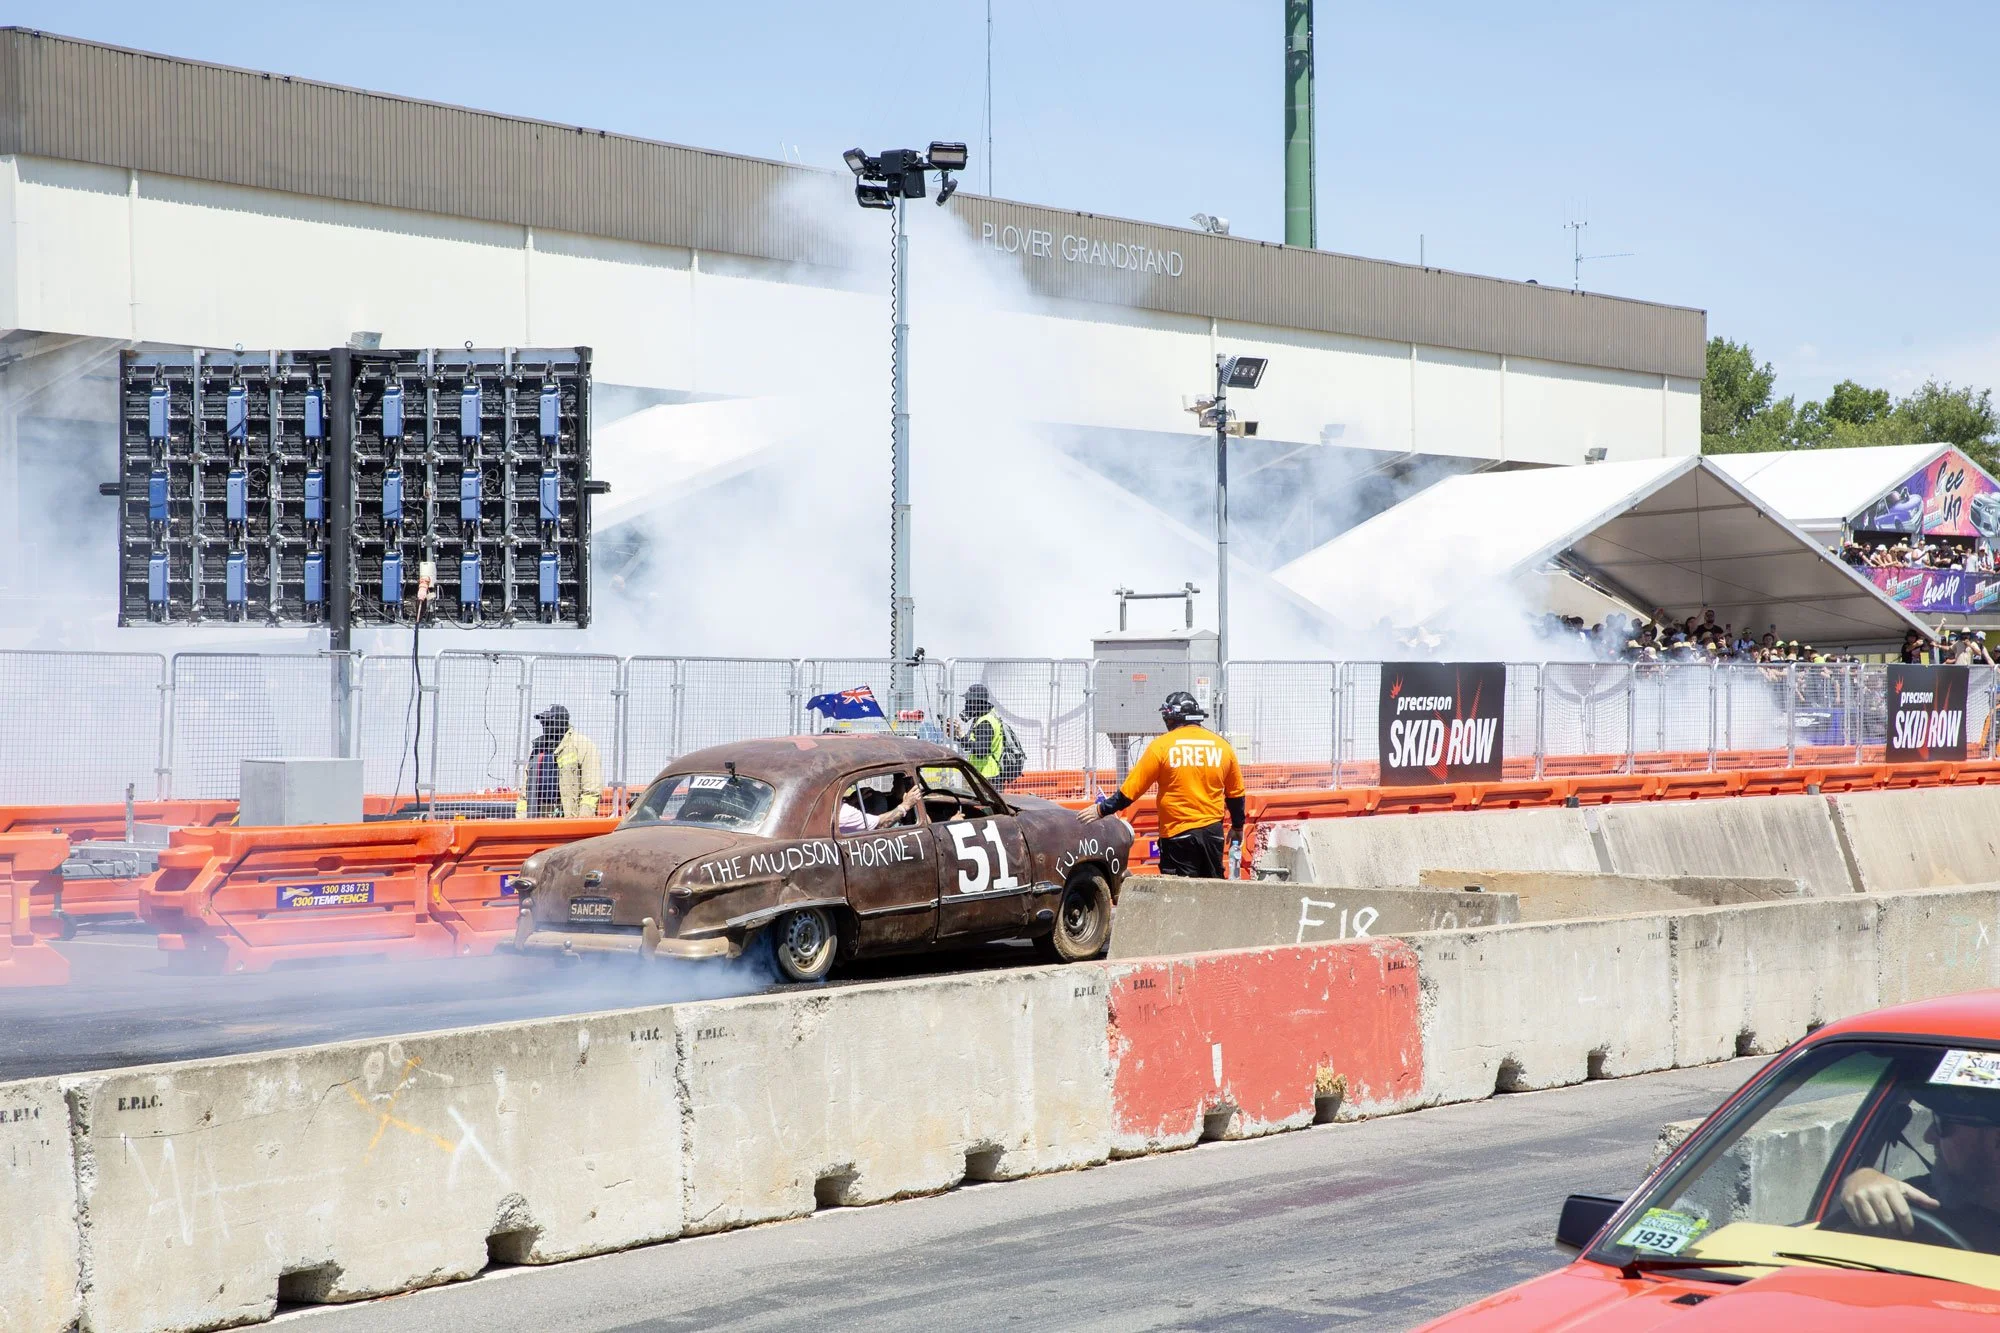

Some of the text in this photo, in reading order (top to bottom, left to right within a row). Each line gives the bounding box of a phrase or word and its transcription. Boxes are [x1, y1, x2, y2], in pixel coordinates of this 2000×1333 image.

[981, 222, 1184, 278] PLOVER GRANDSTAND
[1396, 696, 1452, 715] precision
[1900, 691, 1934, 707] precision
[1893, 709, 1962, 749] SKID ROW
[1388, 717, 1498, 768] SKID ROW
[1168, 745, 1223, 769] CREW
[697, 778, 723, 787] 1077
[702, 830, 926, 885] THE MUDSON HORNET
[946, 819, 1018, 894] 51
[321, 883, 370, 894] 1300 836 733
[571, 903, 613, 916] SANCHEZ
[117, 1094, 163, 1112] E.P.I.C.
[1632, 1229, 1678, 1250] 1933
